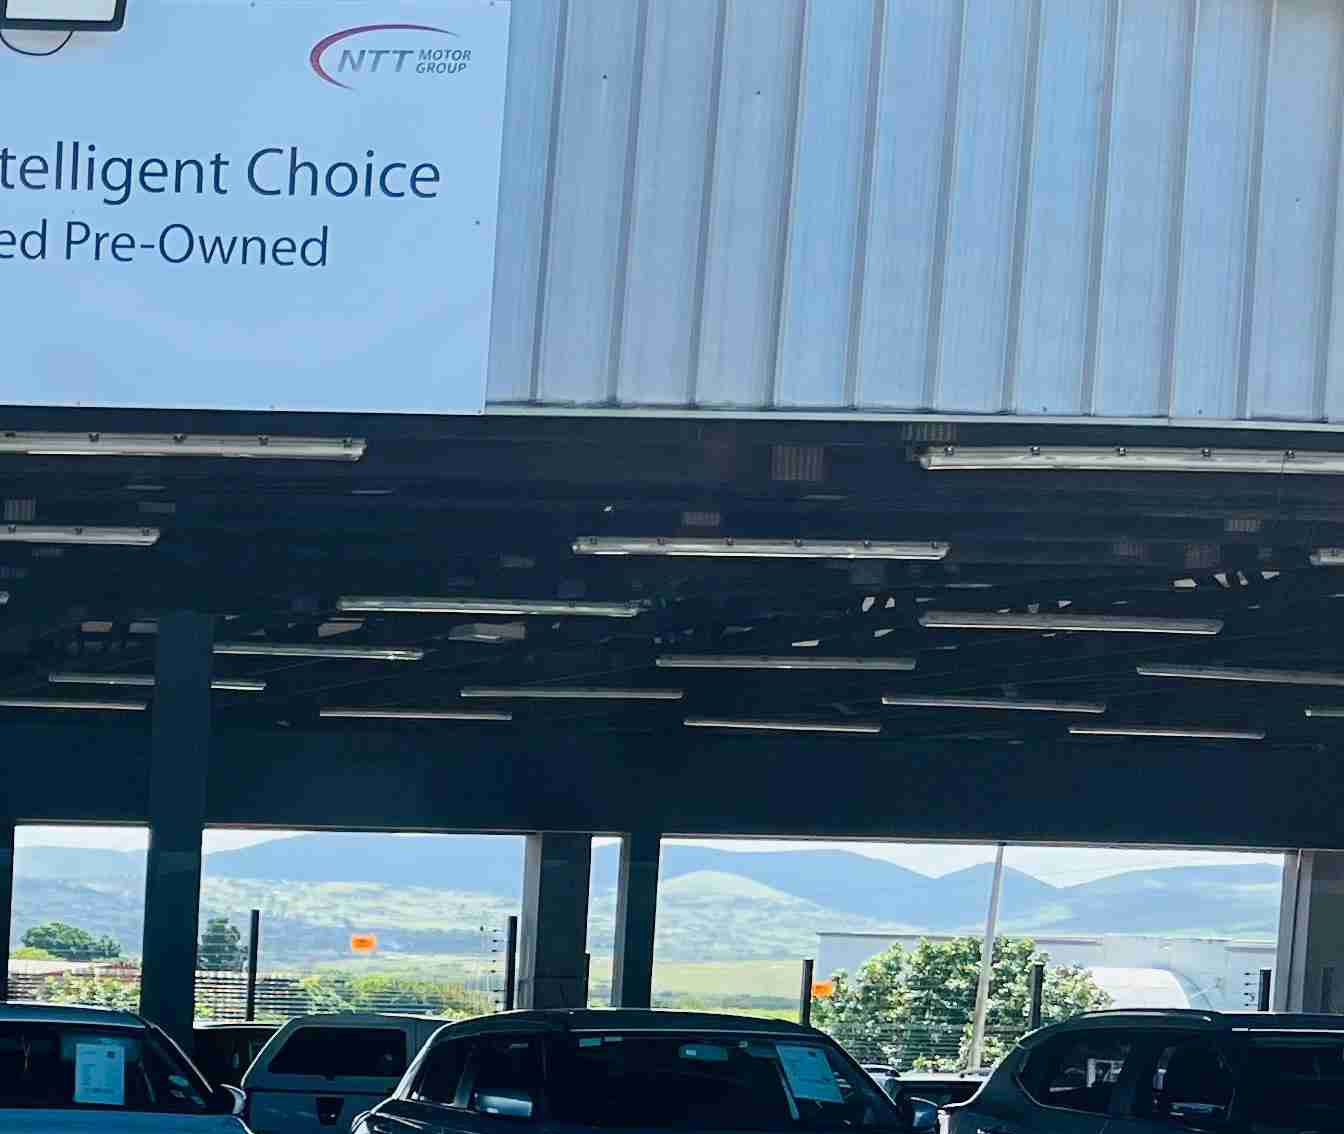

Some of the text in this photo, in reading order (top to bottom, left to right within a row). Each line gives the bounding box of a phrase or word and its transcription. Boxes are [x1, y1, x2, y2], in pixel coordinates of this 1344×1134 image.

[337, 49, 414, 73] NTT
[418, 49, 472, 62] MOTOR
[415, 61, 467, 75] GROUP
[247, 146, 441, 199] Choice
[65, 220, 329, 267] Pre-Owned
